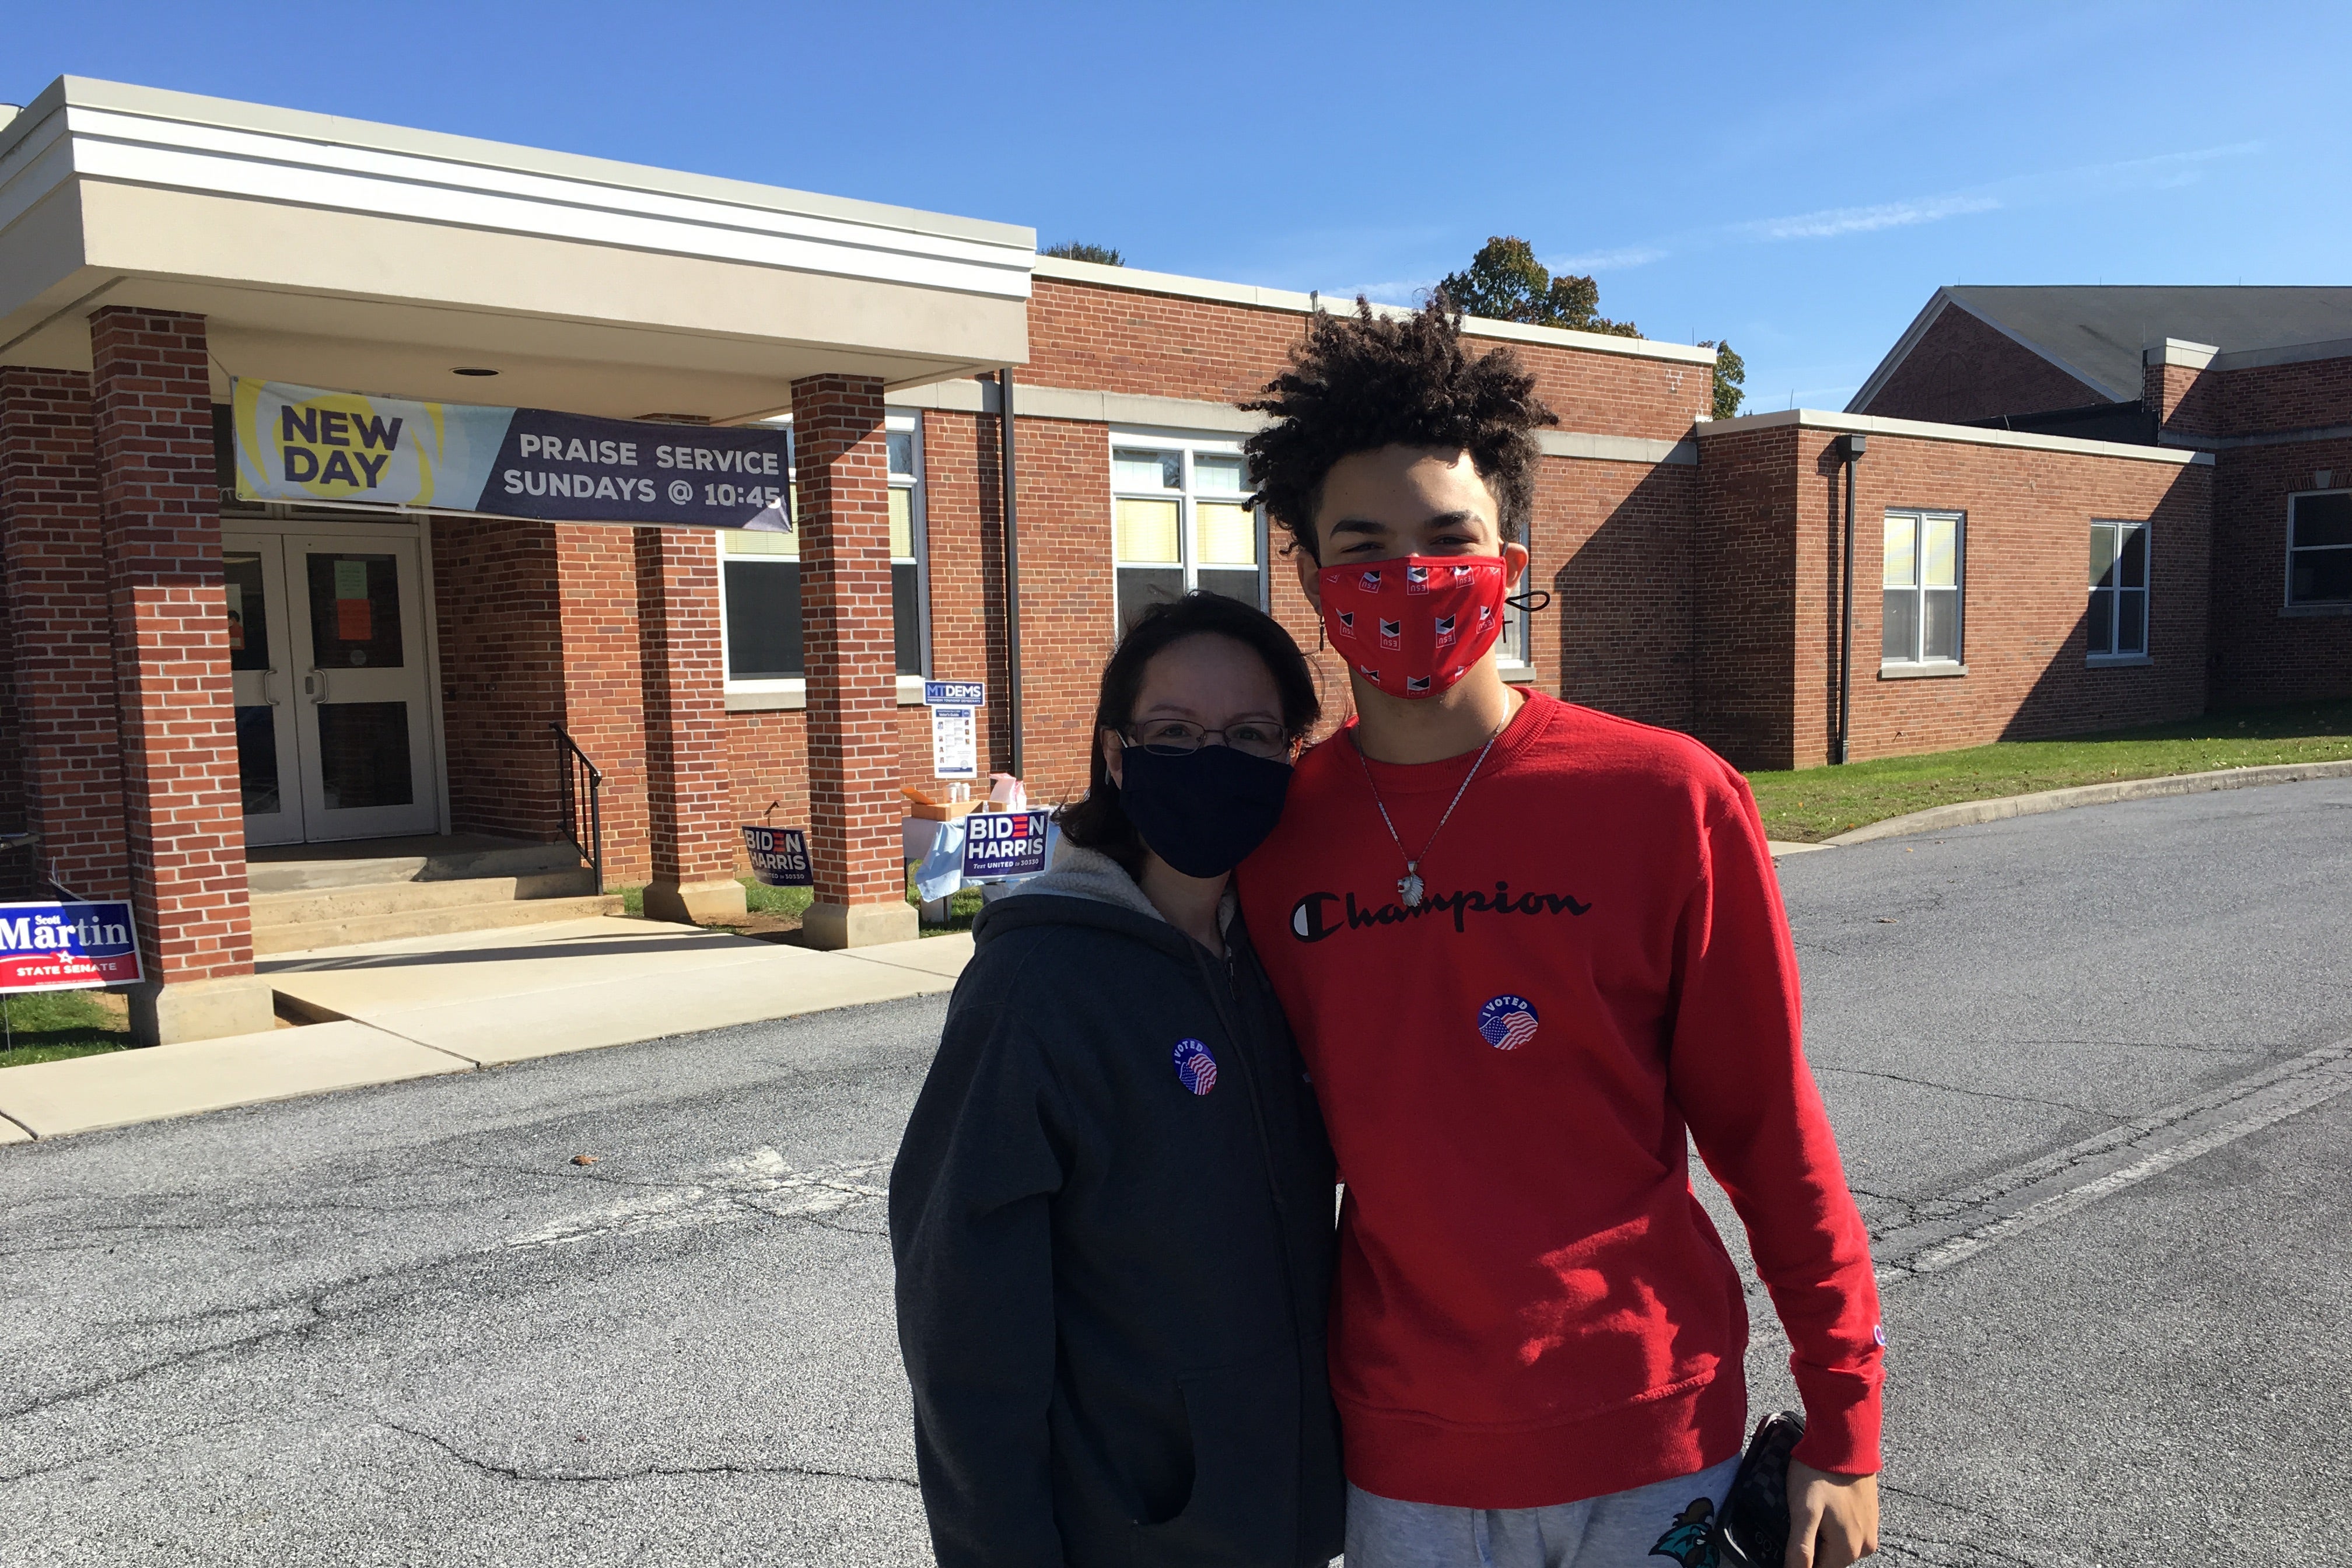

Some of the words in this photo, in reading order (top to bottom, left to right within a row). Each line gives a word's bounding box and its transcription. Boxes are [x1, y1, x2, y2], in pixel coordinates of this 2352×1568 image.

[281, 405, 403, 451] NEW
[520, 433, 638, 466] PRAISE
[656, 444, 779, 475] SERVICE
[284, 446, 388, 488] DAY
[503, 469, 656, 502] SUNDAYS
[668, 480, 693, 505] @
[705, 483, 781, 509] 10:45
[1362, 581, 1377, 590] ESU
[1459, 576, 1471, 585] ESU
[1383, 639, 1397, 647] ESU
[1439, 635, 1452, 645] ESU
[970, 816, 1044, 839] BIDEN
[744, 830, 802, 852] BIDEN
[968, 838, 1043, 859] HARRIS
[749, 850, 806, 870] HARRIS
[35, 915, 61, 925] Scott
[1289, 880, 1592, 943] Champion
[0, 916, 130, 950] Martin
[16, 965, 61, 977] STATE
[64, 963, 117, 974] SENATE
[1485, 997, 1528, 1011] VOTED
[1174, 1041, 1203, 1058] VOTED
